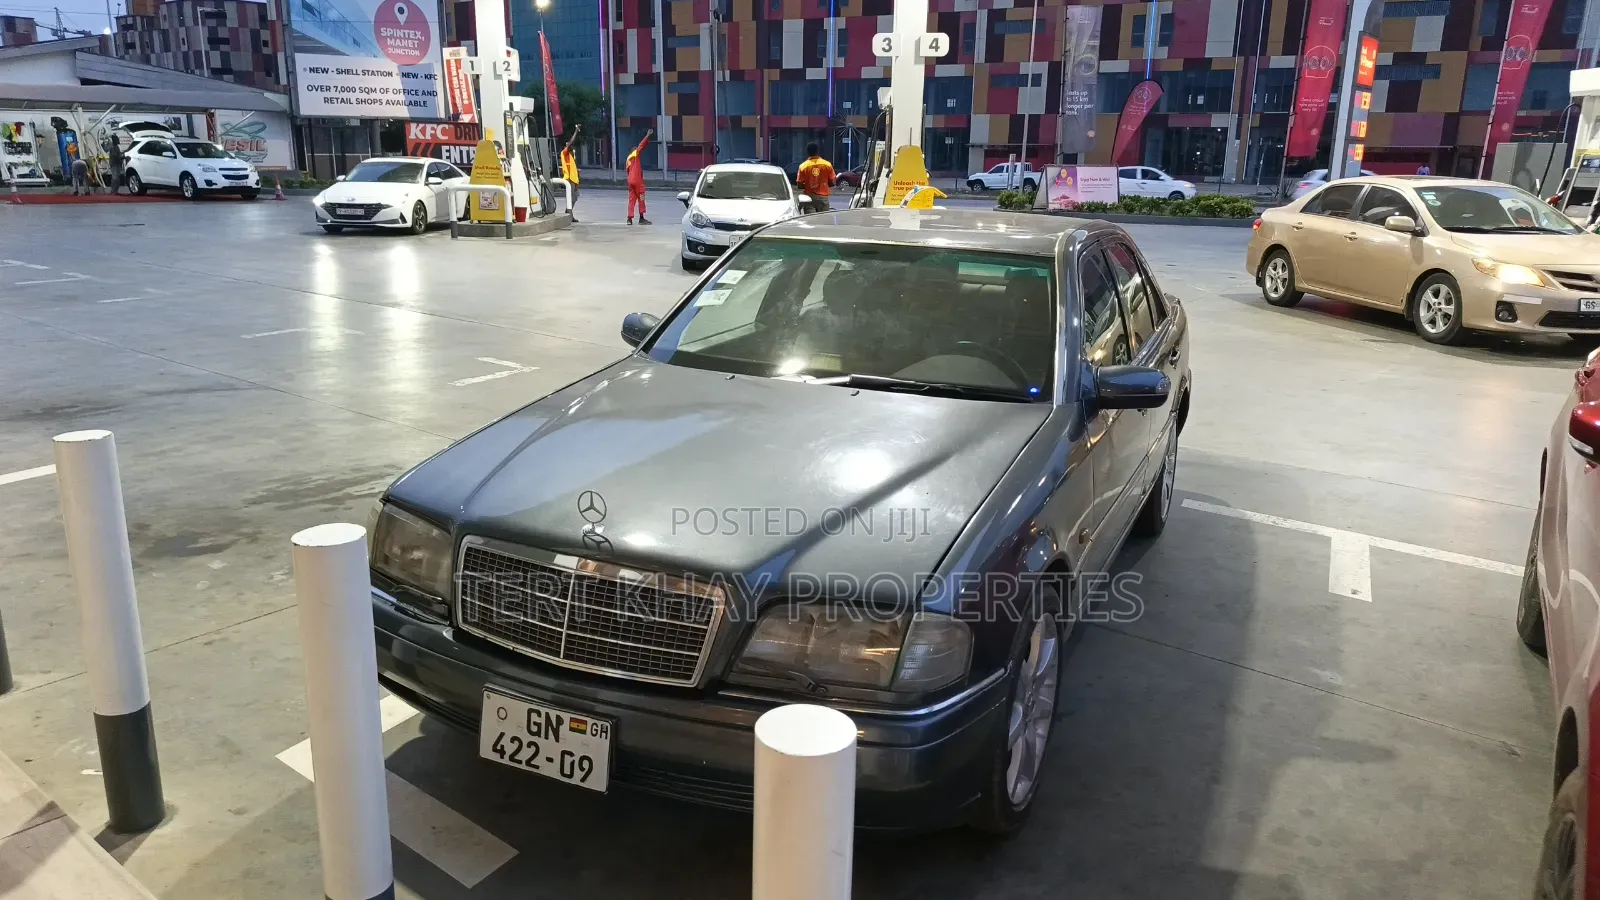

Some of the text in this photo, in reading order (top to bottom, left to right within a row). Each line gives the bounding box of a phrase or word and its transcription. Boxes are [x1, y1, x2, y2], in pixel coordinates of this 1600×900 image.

[380, 27, 425, 41] SPINTEX,
[387, 37, 419, 48] MANET
[881, 37, 893, 53] 3
[928, 37, 941, 52] 4
[387, 47, 420, 56] JUNCTION
[308, 66, 330, 75] NEW
[335, 67, 361, 77] SHELL
[361, 69, 394, 78] STATION
[469, 60, 475, 72] 1
[502, 60, 511, 72] 2
[401, 72, 420, 80] NEW
[424, 73, 438, 81] KFC
[306, 84, 332, 93] OVER
[333, 85, 357, 95] 7,000
[358, 87, 378, 96] SQM
[392, 88, 420, 97] OFFICE
[323, 97, 428, 107] RETAIL SHOPS AVAILABLE
[1066, 102, 1083, 111] longer
[409, 123, 449, 139] KFC
[1585, 301, 1596, 310] GS
[526, 707, 609, 743] GN GH
[491, 731, 594, 784] 422-09
